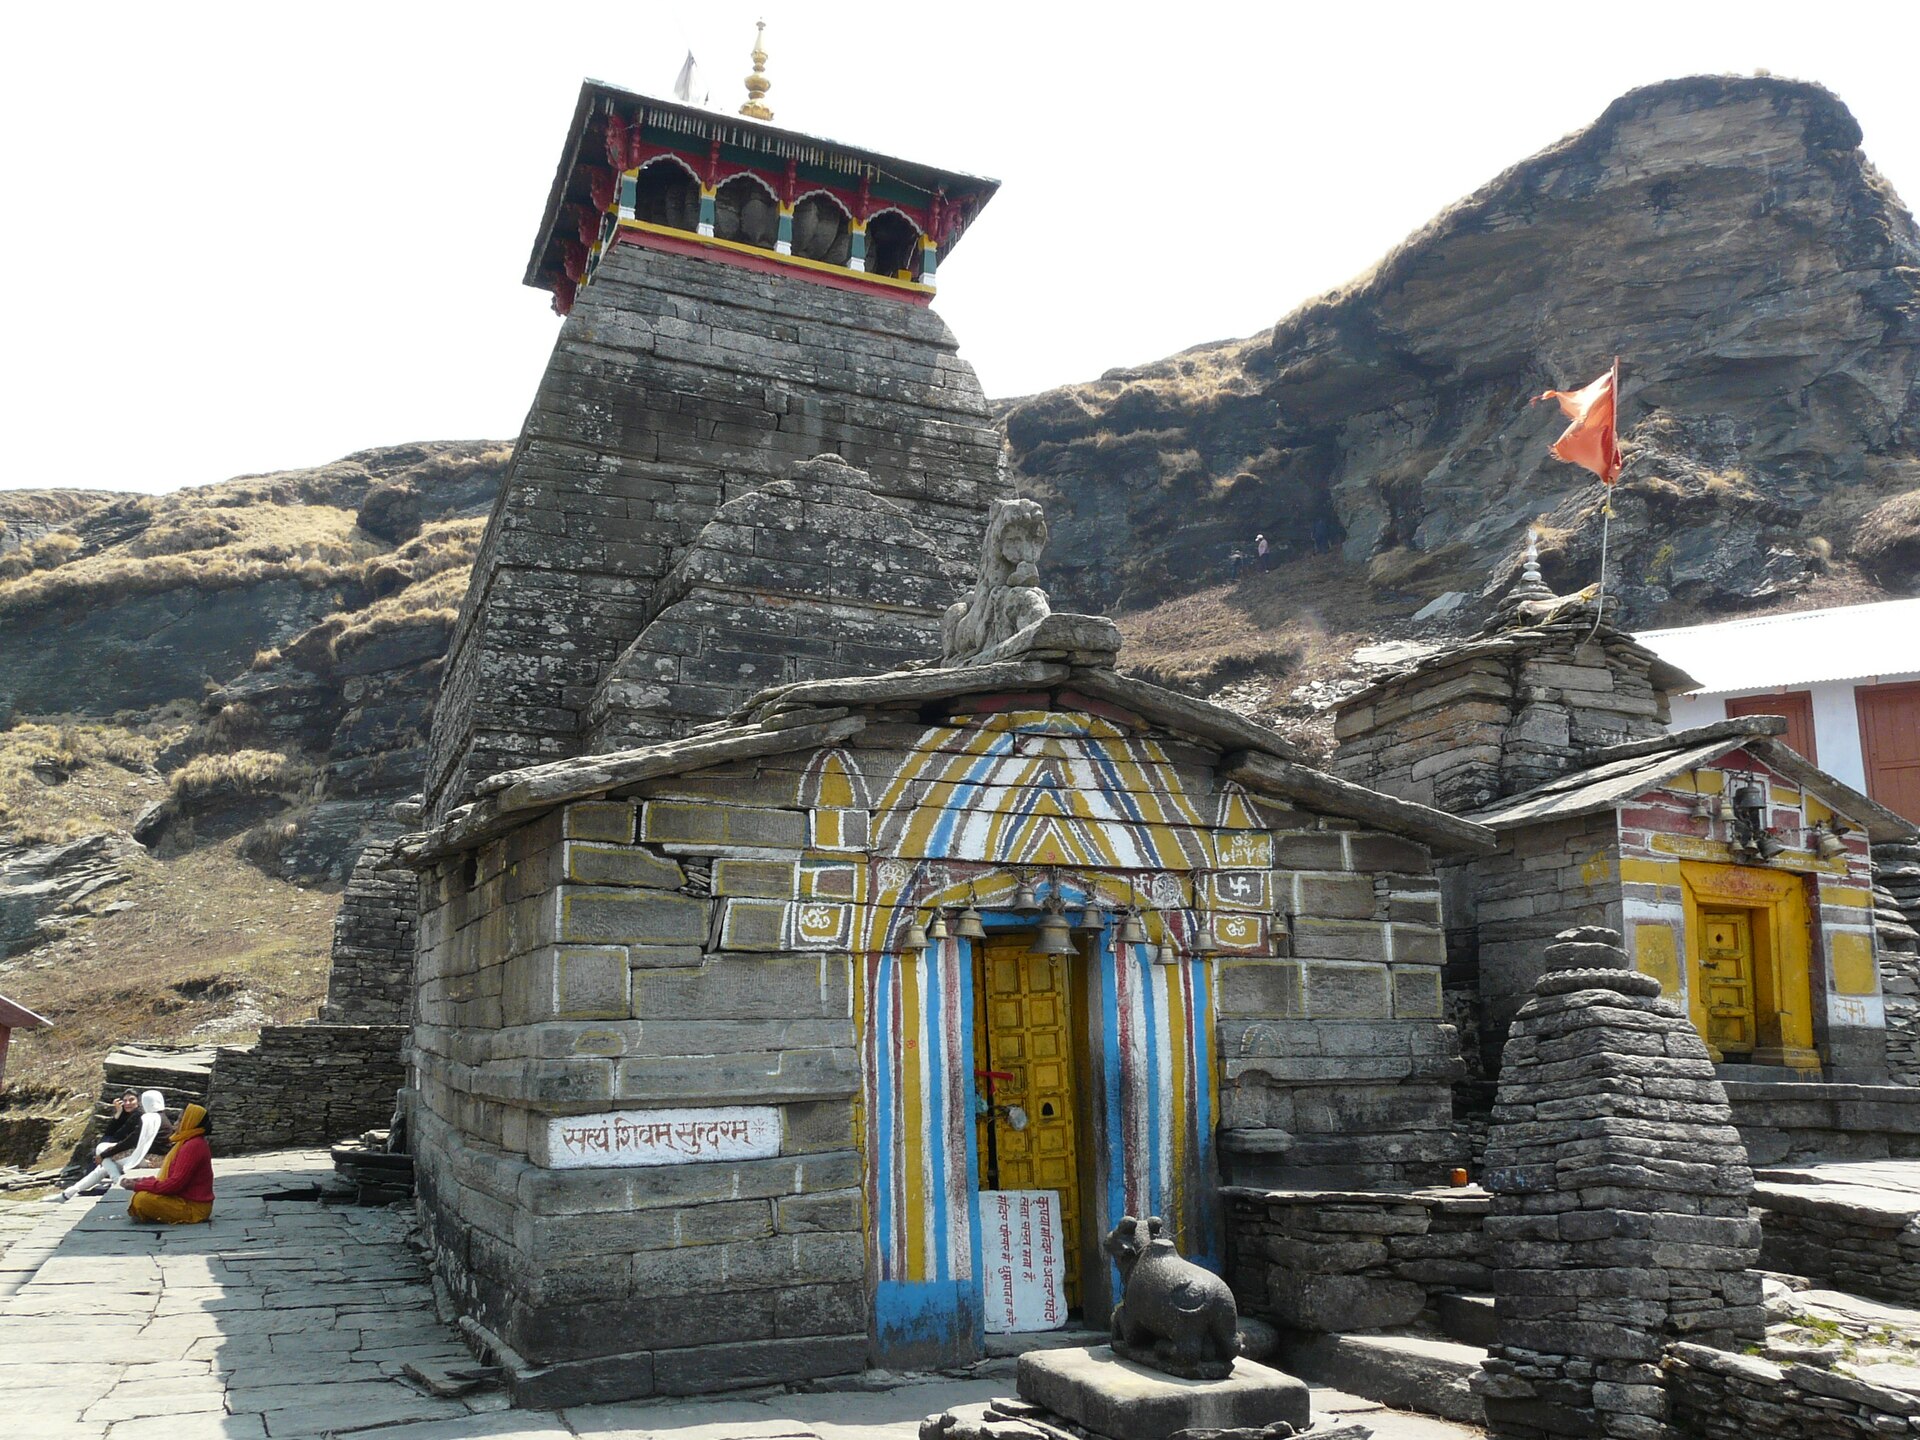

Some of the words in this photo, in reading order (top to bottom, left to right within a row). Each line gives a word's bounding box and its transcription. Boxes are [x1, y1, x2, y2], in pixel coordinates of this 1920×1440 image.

[562, 1120, 610, 1157] सत्यं
[614, 1116, 678, 1152] शिवम्
[1042, 1255, 1057, 1266] के
